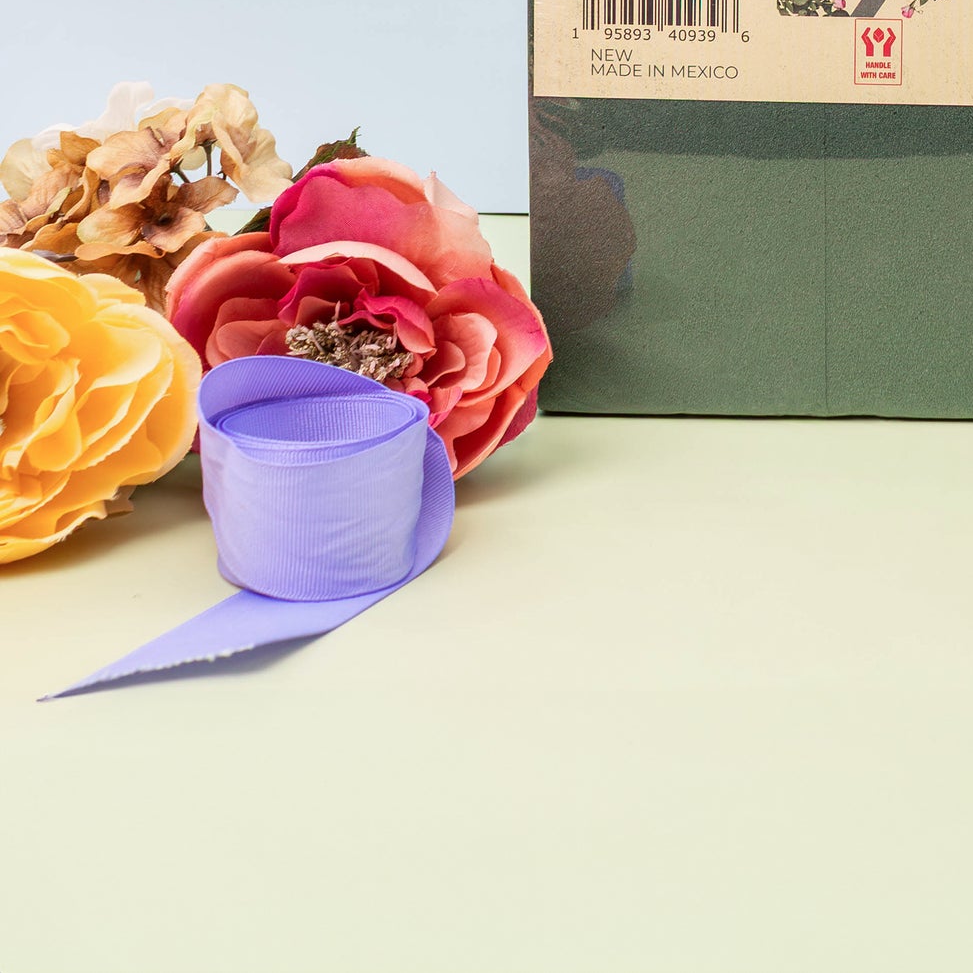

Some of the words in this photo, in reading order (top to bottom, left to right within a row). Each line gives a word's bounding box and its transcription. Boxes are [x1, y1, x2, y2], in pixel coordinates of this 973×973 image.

[572, 28, 579, 39] 1
[604, 28, 651, 40] 95893
[668, 29, 716, 42] 40939
[741, 31, 750, 43] 6
[591, 48, 633, 62] NEW
[591, 63, 642, 77] MADE
[648, 64, 665, 78] IN
[671, 65, 739, 79] MEXICO
[865, 61, 892, 69] HANDLE
[860, 71, 877, 79] WITH
[878, 71, 896, 79] CARE
